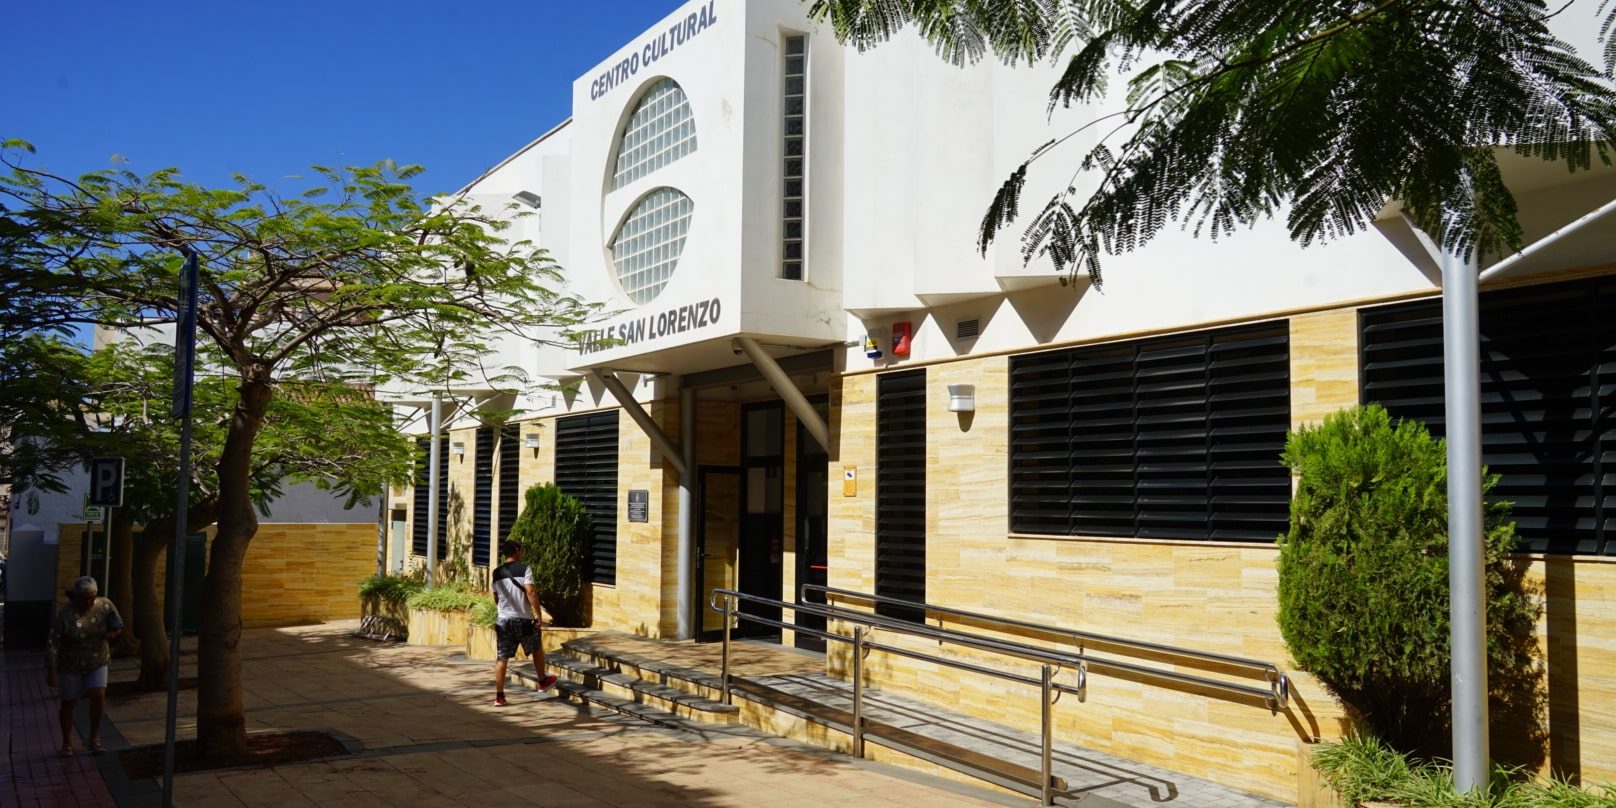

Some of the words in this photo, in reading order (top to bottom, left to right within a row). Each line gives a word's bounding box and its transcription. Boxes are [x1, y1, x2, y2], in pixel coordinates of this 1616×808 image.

[591, 52, 639, 101] CENTRO
[642, 0, 717, 67] CULTURAL
[578, 325, 615, 356] VALLE
[618, 317, 646, 346] SAN
[648, 297, 721, 340] LORENZO
[96, 463, 117, 502] P
